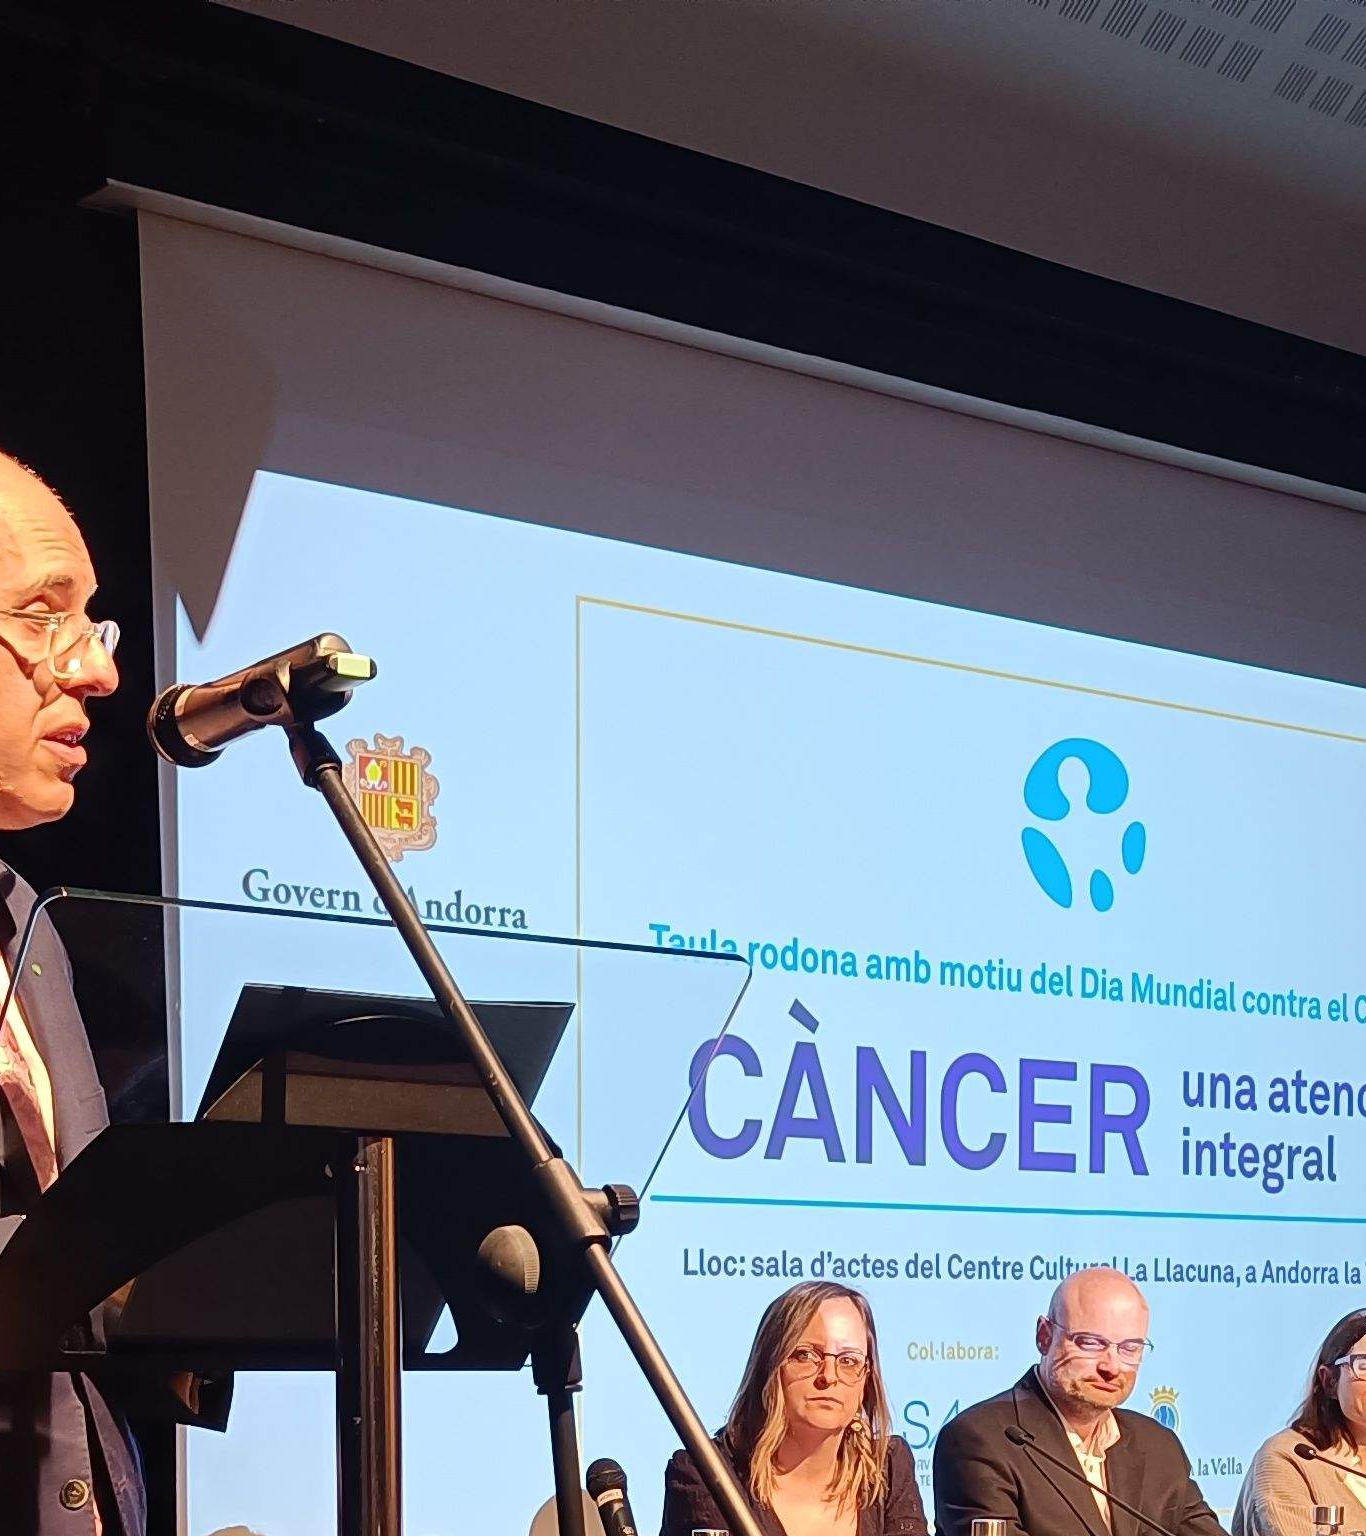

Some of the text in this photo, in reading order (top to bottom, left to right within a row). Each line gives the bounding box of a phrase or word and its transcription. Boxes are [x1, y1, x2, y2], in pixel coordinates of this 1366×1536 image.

[242, 868, 363, 913] Govern
[748, 937, 858, 978] rodona
[865, 949, 931, 984] amb
[939, 958, 1022, 992] motiu
[1030, 962, 1073, 997] del
[1080, 966, 1124, 1002] Dia
[1131, 971, 1236, 1012] Mundial
[1241, 988, 1322, 1020] contra
[1327, 992, 1349, 1023] el
[688, 998, 1151, 1177] CÀNCER
[1181, 1068, 1258, 1112] una
[1181, 1126, 1337, 1195] integral
[683, 1248, 746, 1277] Lloc:
[751, 1249, 804, 1279] sala
[905, 1252, 942, 1280] del
[947, 1253, 1024, 1281] Centre
[1153, 1256, 1242, 1288] Llacuna,
[1245, 1265, 1257, 1284] a
[1261, 1258, 1340, 1285] Andorra
[1344, 1260, 1362, 1285] la
[1197, 1456, 1243, 1476] la Vella
